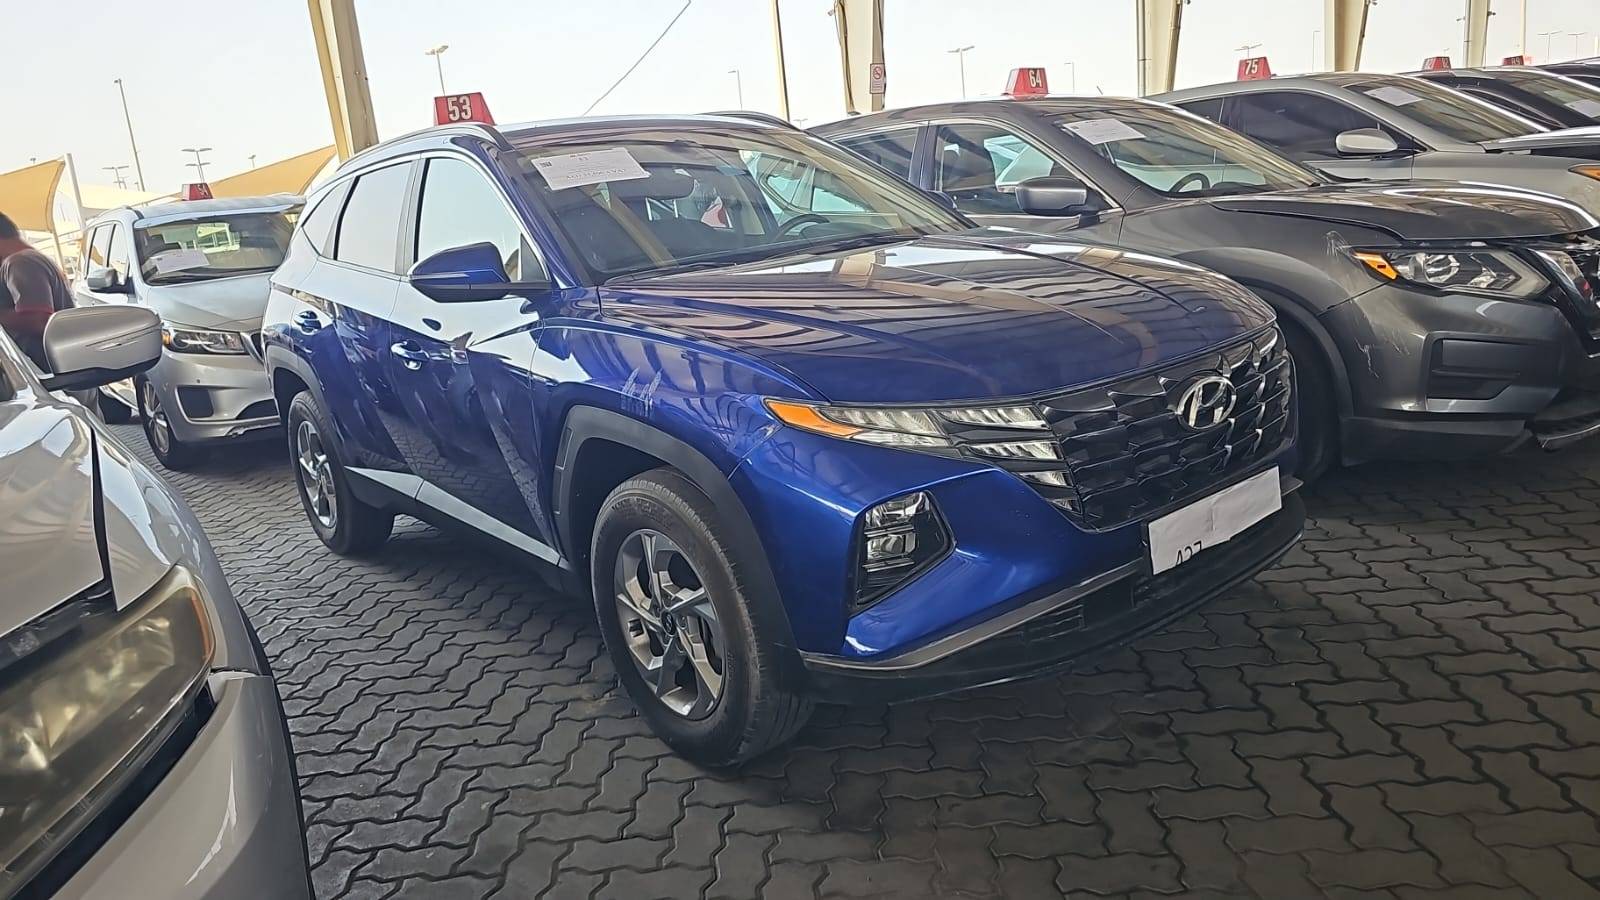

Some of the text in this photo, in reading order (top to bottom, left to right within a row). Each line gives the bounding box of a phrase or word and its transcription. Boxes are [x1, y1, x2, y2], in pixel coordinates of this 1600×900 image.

[1245, 59, 1259, 76] 75
[1029, 69, 1043, 88] 64
[447, 95, 472, 121] 53
